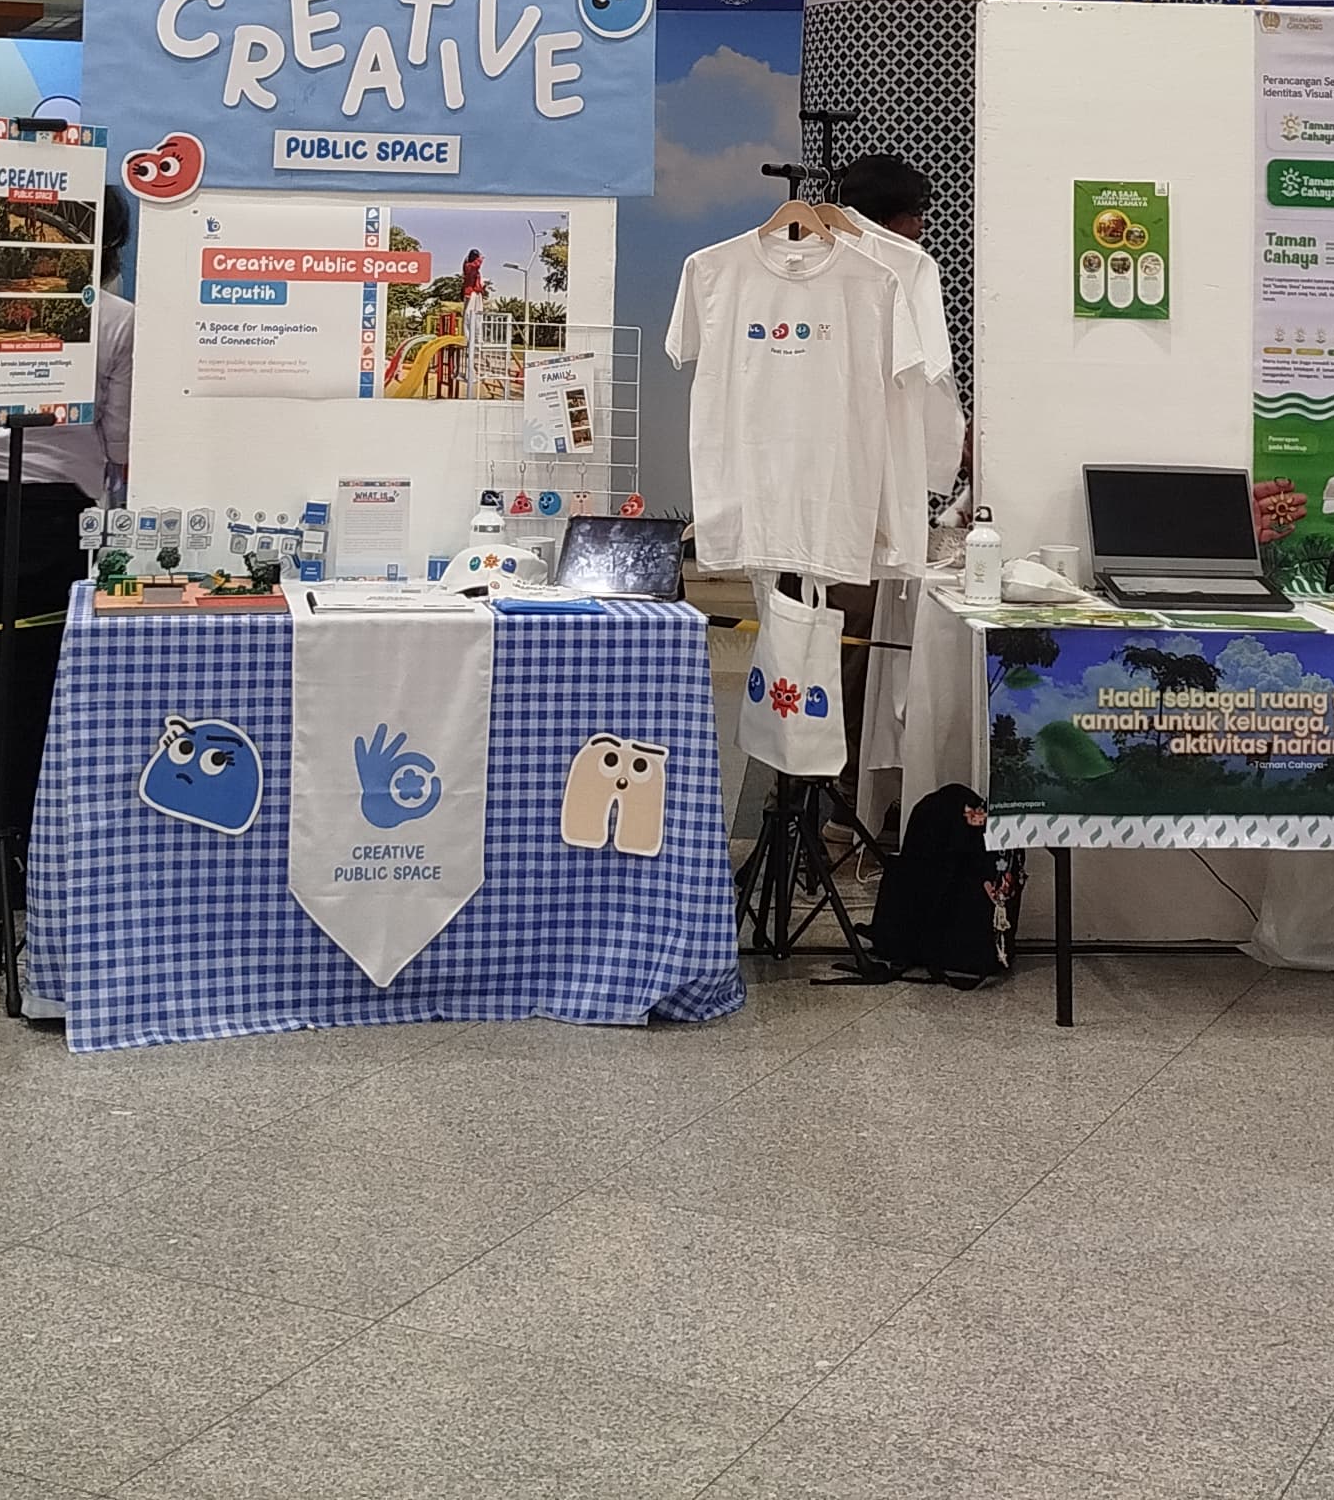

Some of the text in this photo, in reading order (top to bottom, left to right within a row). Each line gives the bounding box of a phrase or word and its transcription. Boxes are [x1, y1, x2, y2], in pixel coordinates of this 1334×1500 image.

[1262, 75, 1322, 88] Perancangan
[1263, 88, 1303, 98] Identitas
[1305, 89, 1333, 99] Visual
[285, 137, 449, 164] PUBLIC SPACE
[1265, 232, 1317, 248] Taman
[213, 254, 419, 278] Creative Public Space
[1263, 249, 1319, 270] Cahaya
[211, 283, 276, 303] Keputih
[209, 323, 239, 333] Space
[242, 322, 258, 332] for
[260, 324, 318, 335] Imagination
[198, 336, 217, 345] and
[542, 370, 572, 382] FAMILY
[1098, 688, 1161, 709] Hadir
[1164, 689, 1256, 713] sebagai
[1260, 690, 1328, 713] ruang
[1073, 711, 1152, 731] ramah
[1154, 712, 1219, 731] untuk
[1223, 711, 1329, 738] keluarga,
[1170, 736, 1267, 756] aktivitas
[1249, 760, 1328, 771] -Taman Cahaya-
[352, 844, 425, 861] CREATIVE
[334, 865, 442, 882] PUBLIC SPACE
